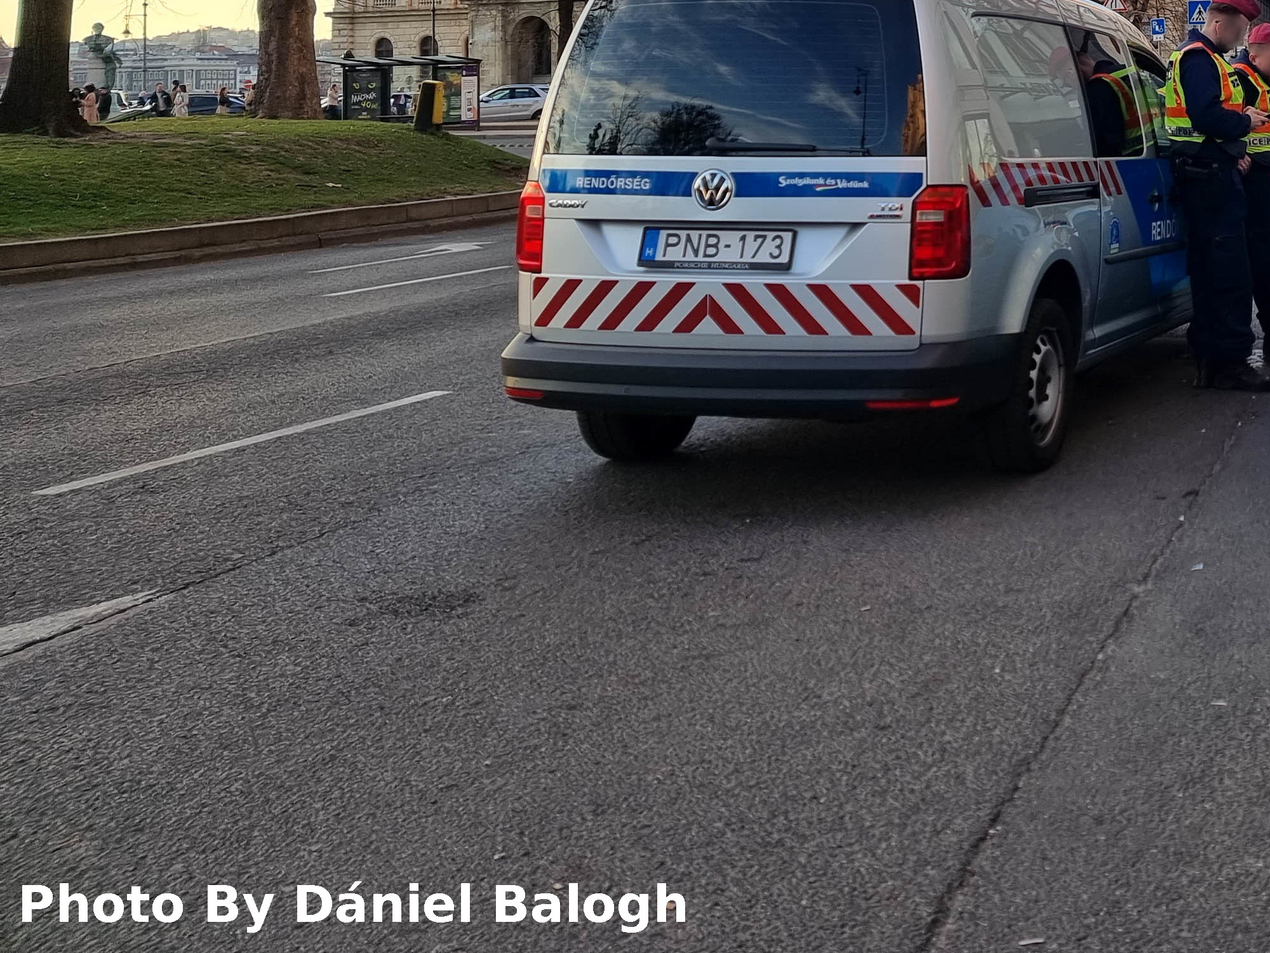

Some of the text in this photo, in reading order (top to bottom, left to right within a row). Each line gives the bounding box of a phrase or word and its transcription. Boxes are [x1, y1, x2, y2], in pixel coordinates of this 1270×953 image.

[575, 174, 650, 190] RENDŐRSÉG
[826, 176, 836, 185] és
[548, 198, 589, 209] CADDY
[662, 232, 784, 260] PNB-173
[645, 248, 653, 257] H
[711, 262, 749, 270] HUNGARIA
